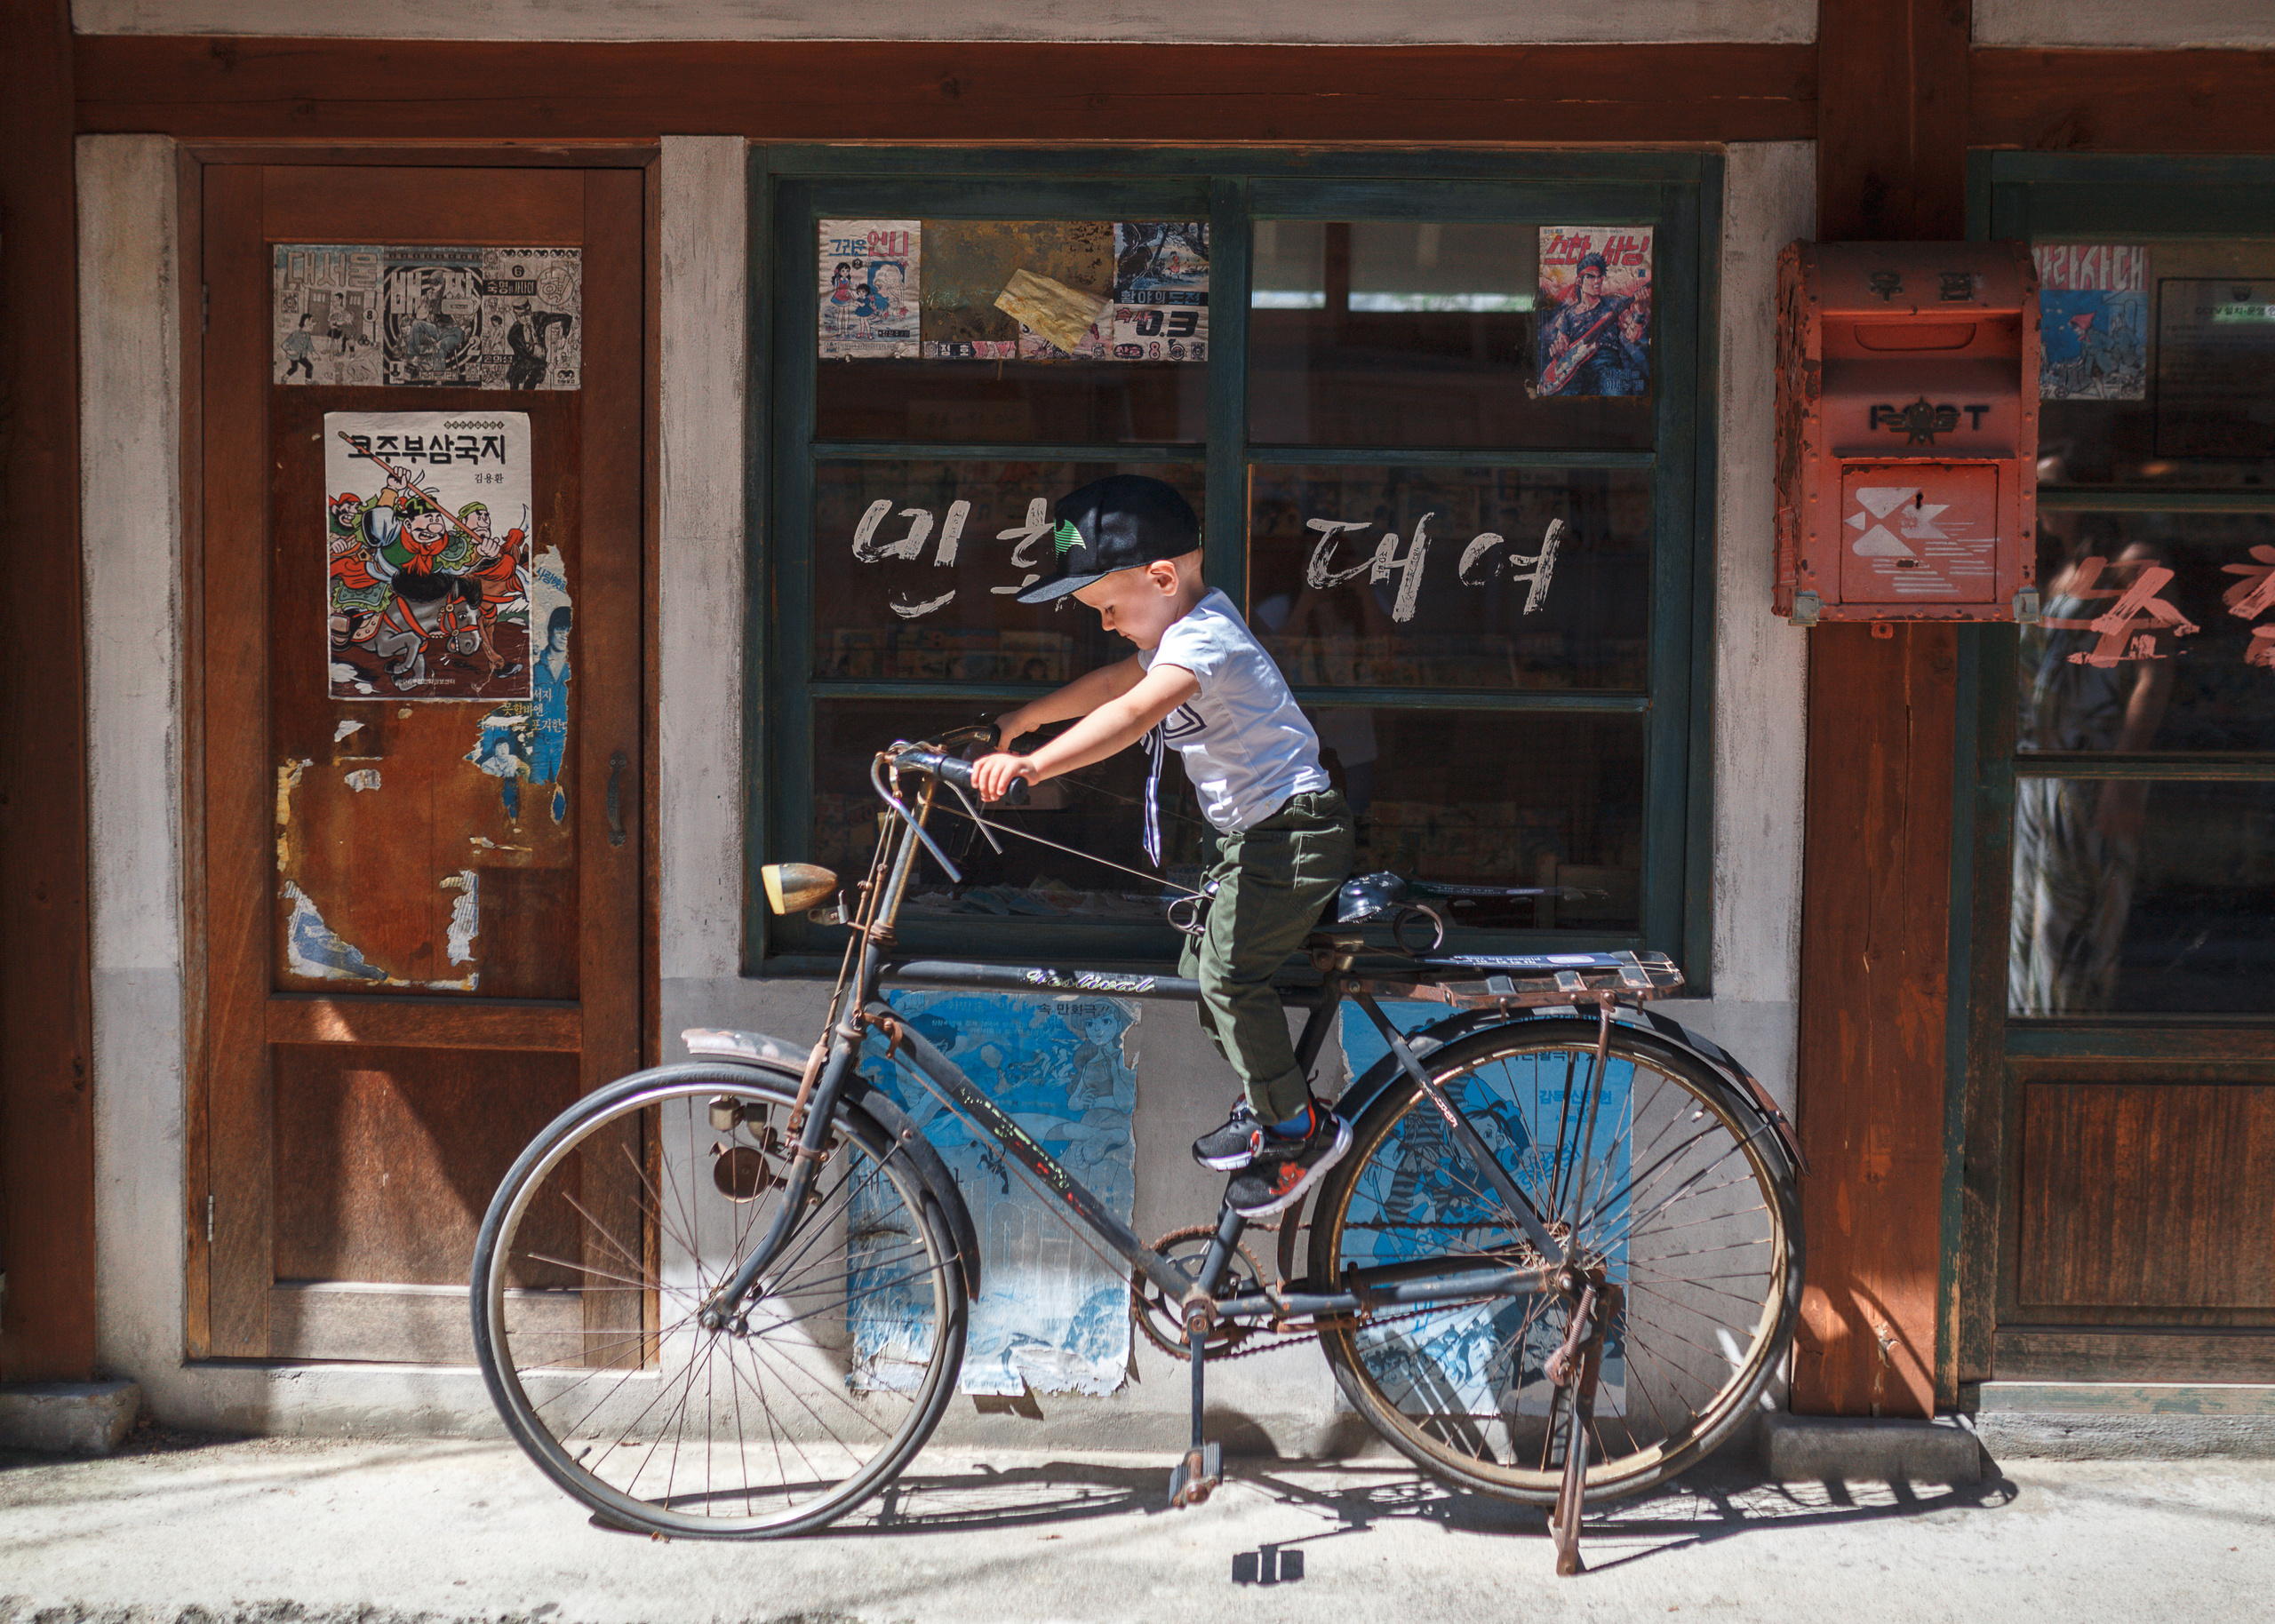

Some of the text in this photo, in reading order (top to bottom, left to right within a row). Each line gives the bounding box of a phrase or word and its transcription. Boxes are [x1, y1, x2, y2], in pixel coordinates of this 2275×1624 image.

[867, 231, 909, 257] 언니
[286, 251, 377, 289] 대서울
[1168, 291, 1201, 306] 도전
[467, 335, 482, 356] 2
[1148, 340, 1161, 361] 8
[1870, 404, 1990, 430] PT
[347, 434, 506, 466] 코주부삼국지
[474, 473, 505, 484] 김용환
[1305, 511, 1566, 623] 대여
